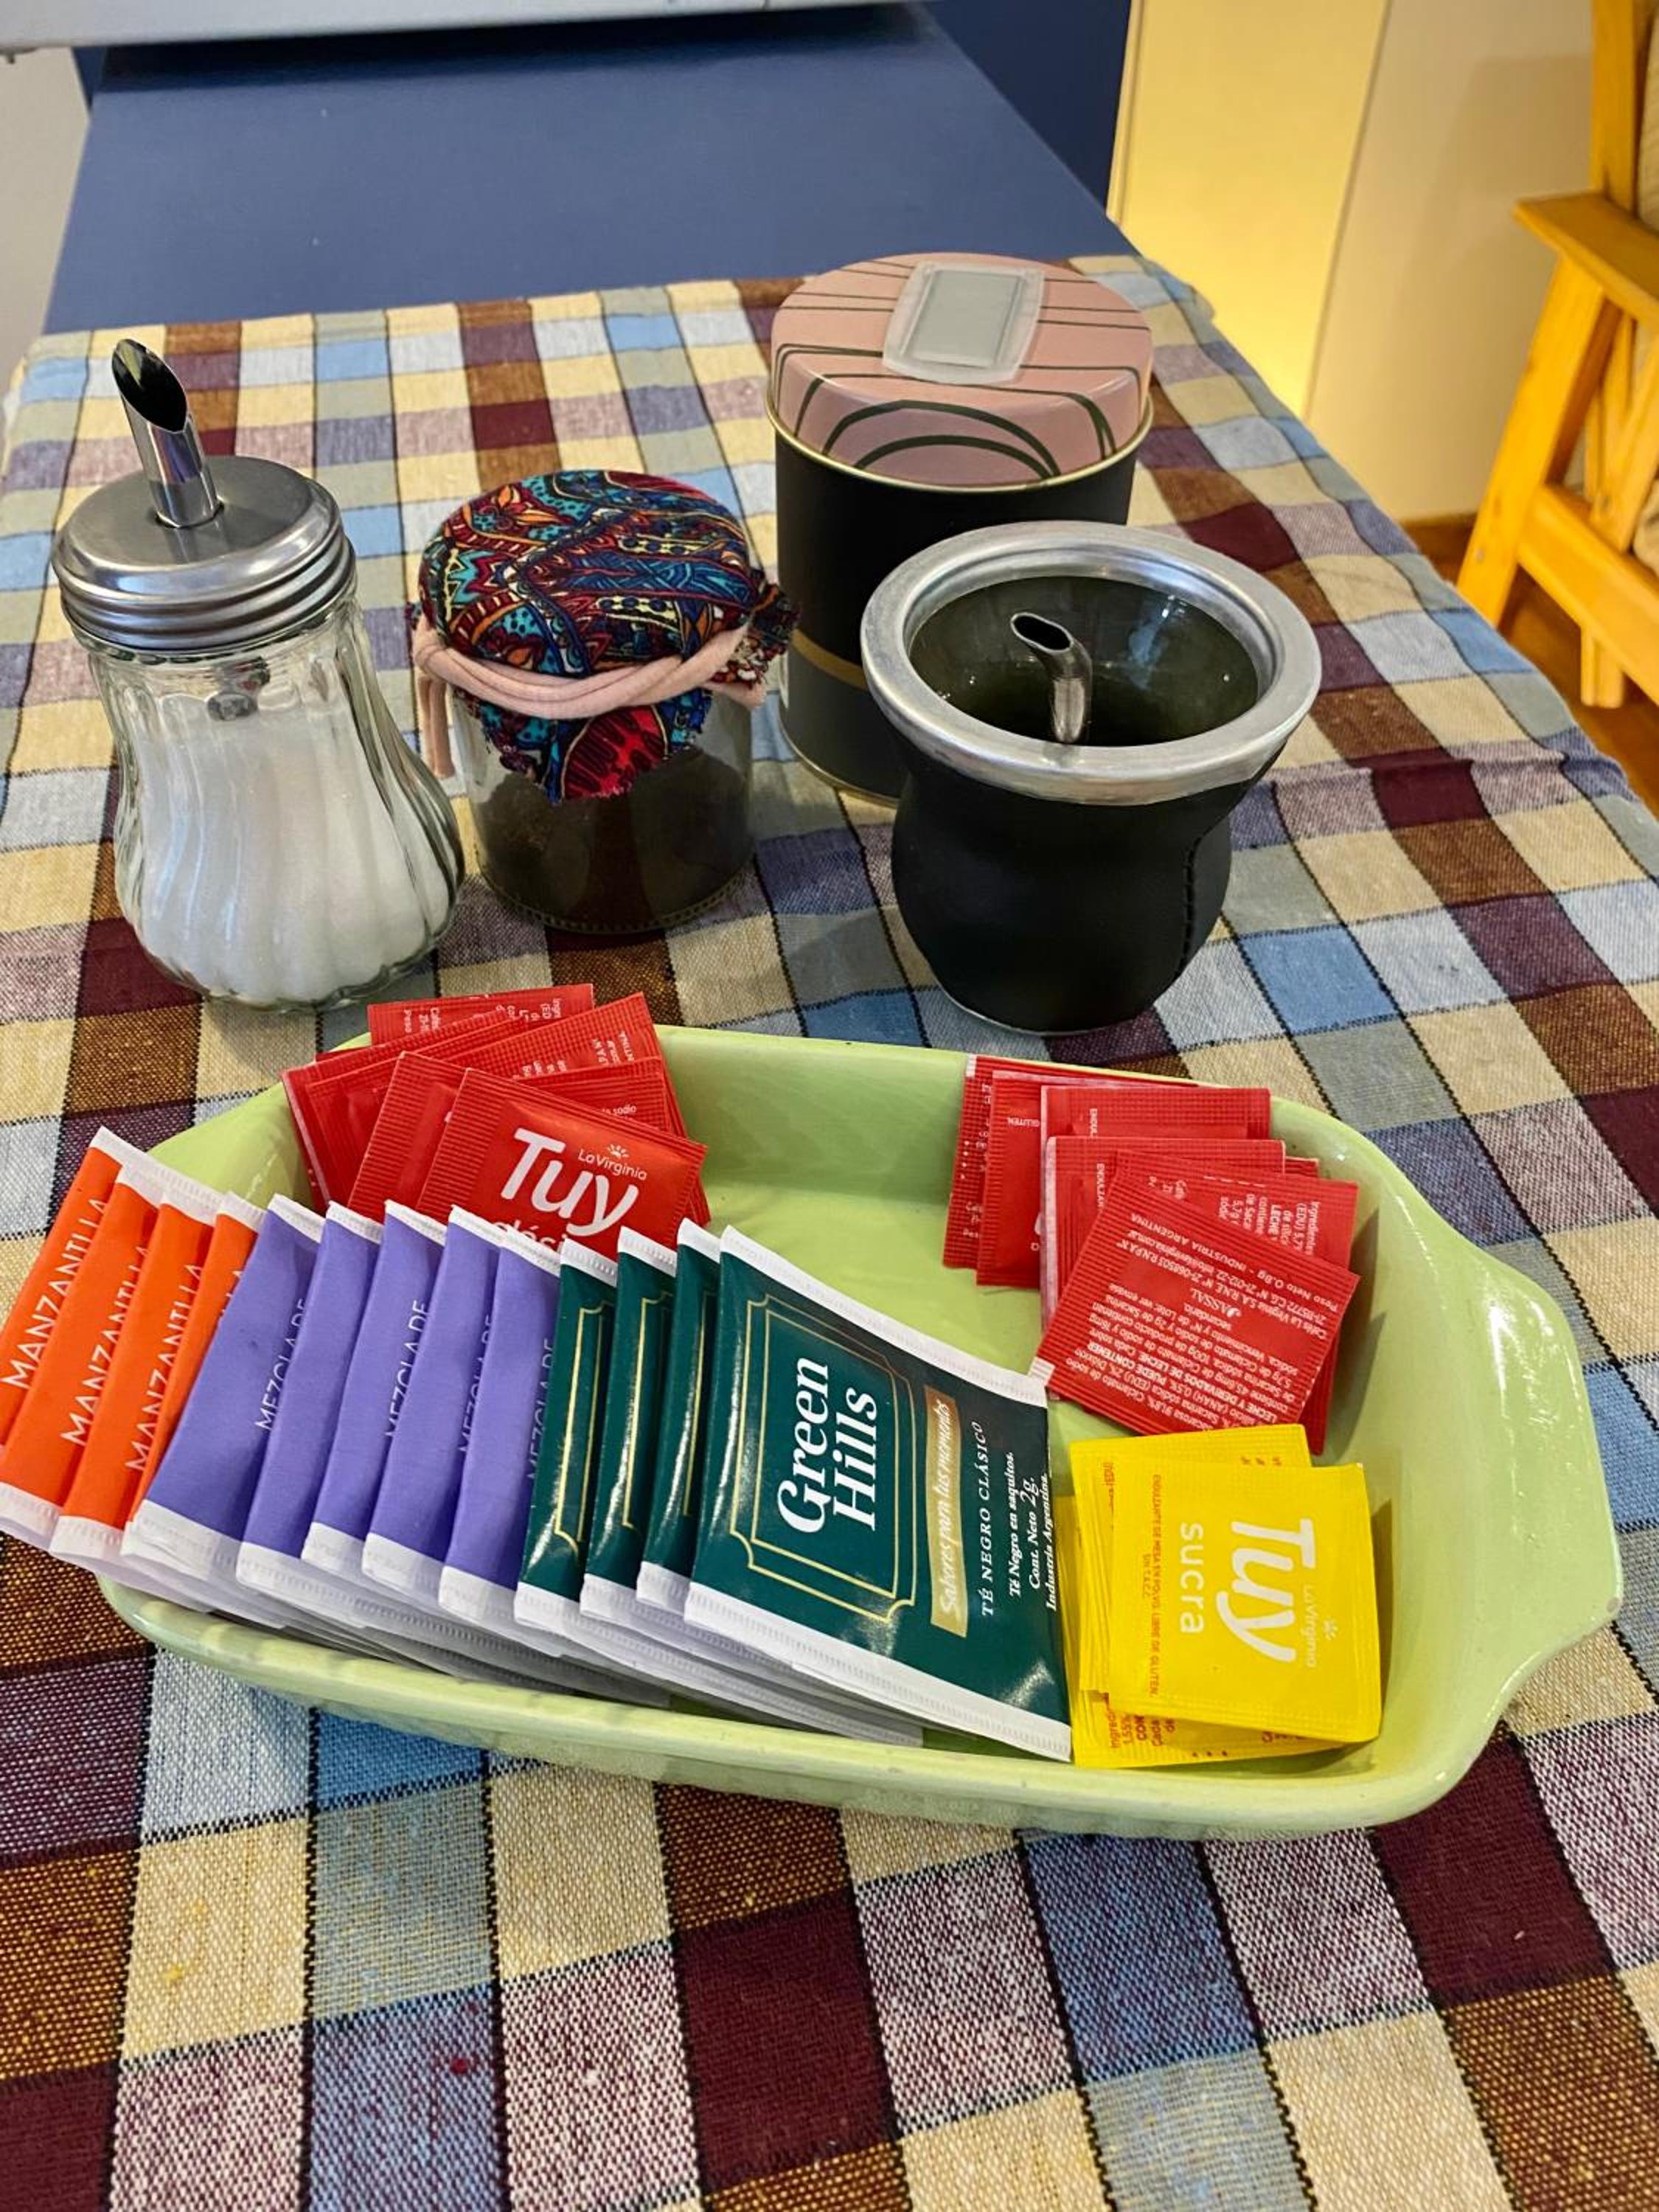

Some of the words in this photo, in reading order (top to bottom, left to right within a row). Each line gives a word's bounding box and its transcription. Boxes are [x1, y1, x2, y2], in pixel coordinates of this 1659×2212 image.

[501, 1127, 640, 1237] Tuy
[1129, 1211, 1191, 1245] ARGENTINA
[1268, 1203, 1281, 1235] LECHE
[1189, 1239, 1248, 1273] INDUSTRIA
[1284, 1281, 1312, 1300] Neto
[1311, 1293, 1338, 1312] Peso
[1111, 1322, 1121, 1332] y
[1140, 1310, 1155, 1324] de
[1166, 1321, 1176, 1331] y
[1288, 1315, 1303, 1328] La
[1111, 1338, 1137, 1357] Cada
[1117, 1327, 1144, 1346] sodio
[1142, 1339, 1157, 1352] de
[1172, 1326, 1200, 1345] sodio
[1173, 1340, 1188, 1352] de
[1198, 1338, 1214, 1352] de
[1085, 1340, 1137, 1370] CONTENER
[1121, 1370, 1152, 1391] (EDU)
[1133, 1363, 1168, 1385] PUEDE
[1168, 1365, 1183, 1379] DE
[1200, 1366, 1214, 1380] de
[1256, 1365, 1272, 1379] de
[1182, 1372, 1239, 1405] DERIVADOS
[1237, 1398, 1247, 1408] Y
[1245, 1402, 1277, 1423] LECHE
[777, 1357, 832, 1533] Green
[832, 1388, 877, 1531] Hills
[972, 1420, 989, 1500] CLÁSICO
[1005, 1450, 1018, 1509] saquitos.
[1019, 1475, 1039, 1507] 2g.
[936, 1500, 959, 1544] para
[1007, 1512, 1018, 1529] en
[1025, 1510, 1039, 1545] Neto
[978, 1507, 993, 1581] NEGRO
[1006, 1531, 1022, 1576] Negro
[1150, 1539, 1160, 1563] MESA
[939, 1543, 957, 1614] Sabores
[1027, 1546, 1041, 1590] Cont.
[1042, 1543, 1057, 1611] Industria
[1180, 1523, 1205, 1634] sucra
[1007, 1577, 1021, 1597] Té
[1215, 1518, 1316, 1663] Tuy
[979, 1587, 994, 1616] TÉ
[1150, 1612, 1159, 1638] LIBRE
[1150, 1640, 1159, 1653] DE
